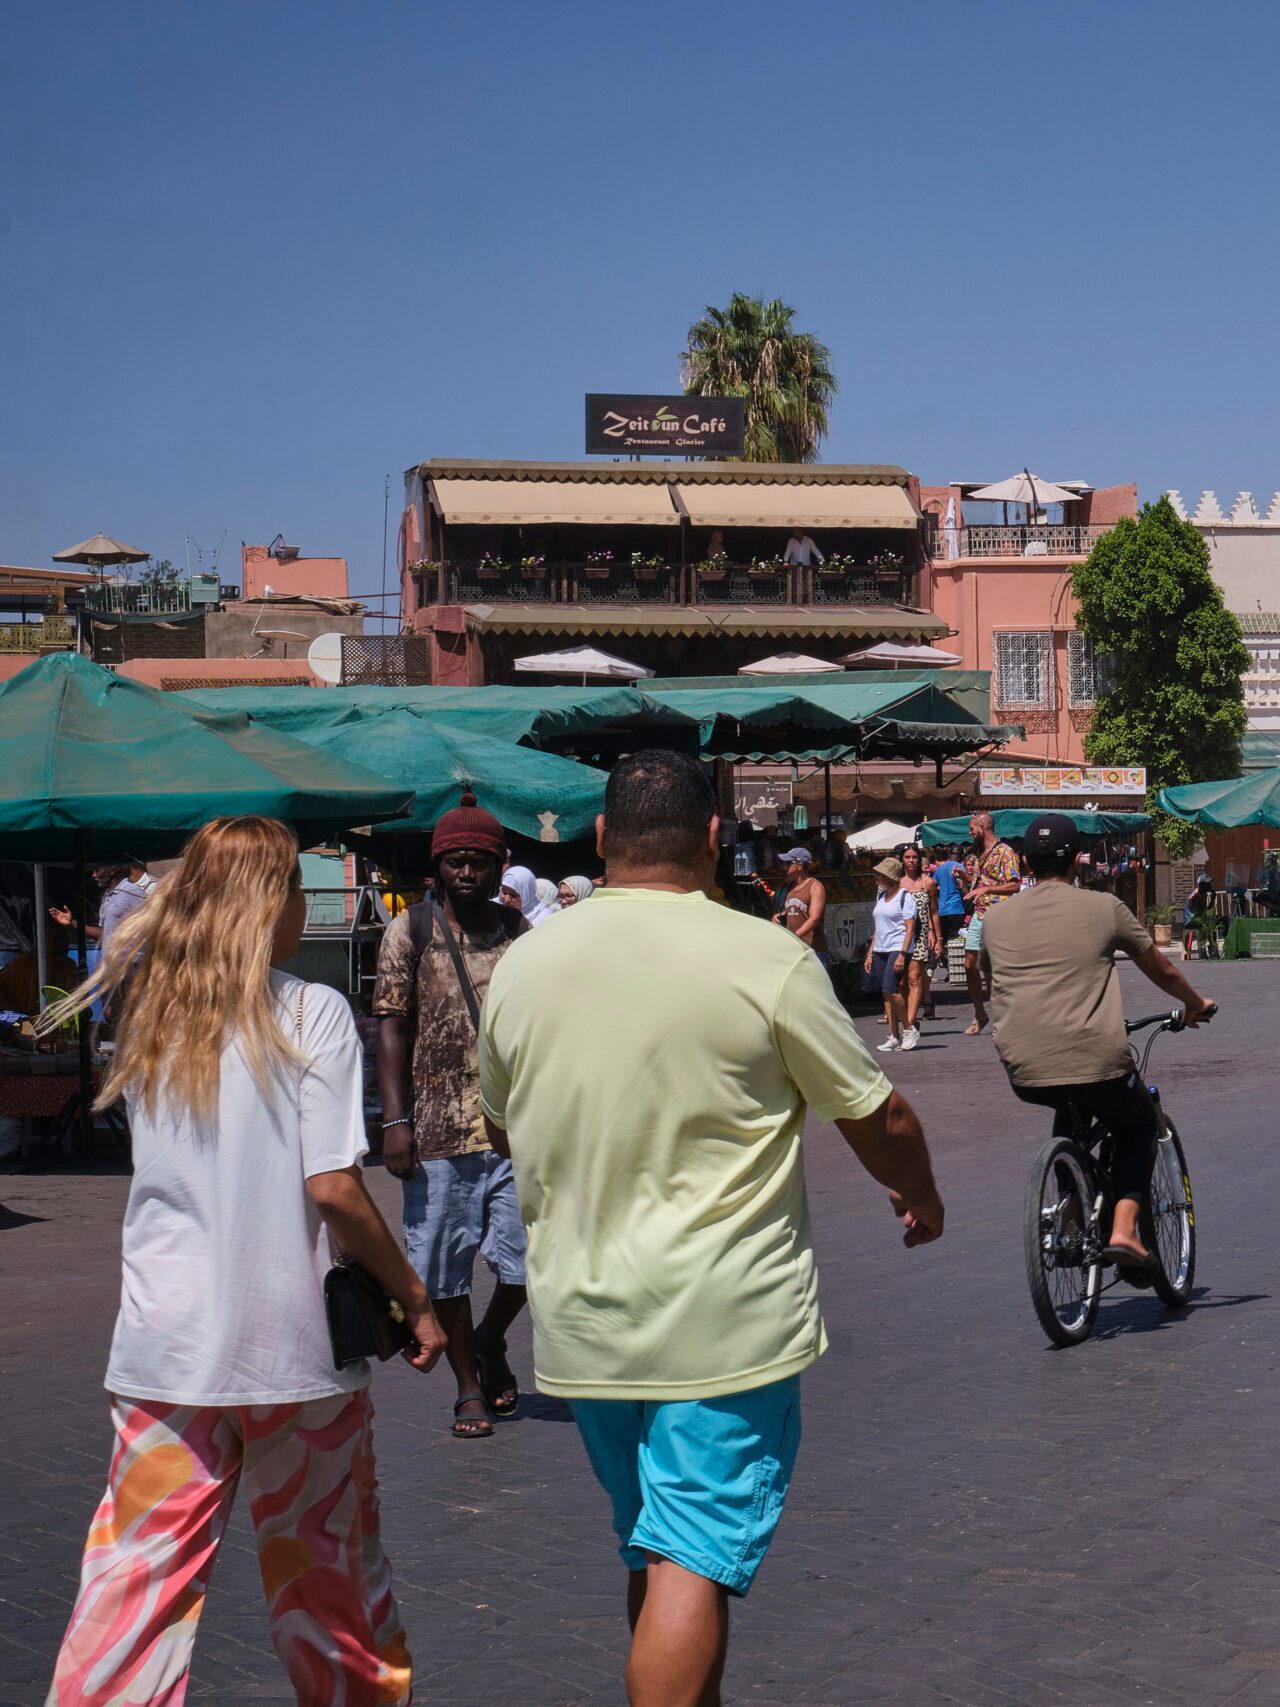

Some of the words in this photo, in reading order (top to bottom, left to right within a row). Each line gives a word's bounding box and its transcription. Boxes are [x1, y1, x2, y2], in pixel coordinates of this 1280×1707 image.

[603, 411, 680, 437] Zeitoun
[683, 414, 727, 435] Café
[624, 437, 670, 446] Restaurant
[675, 438, 706, 447] Glacier
